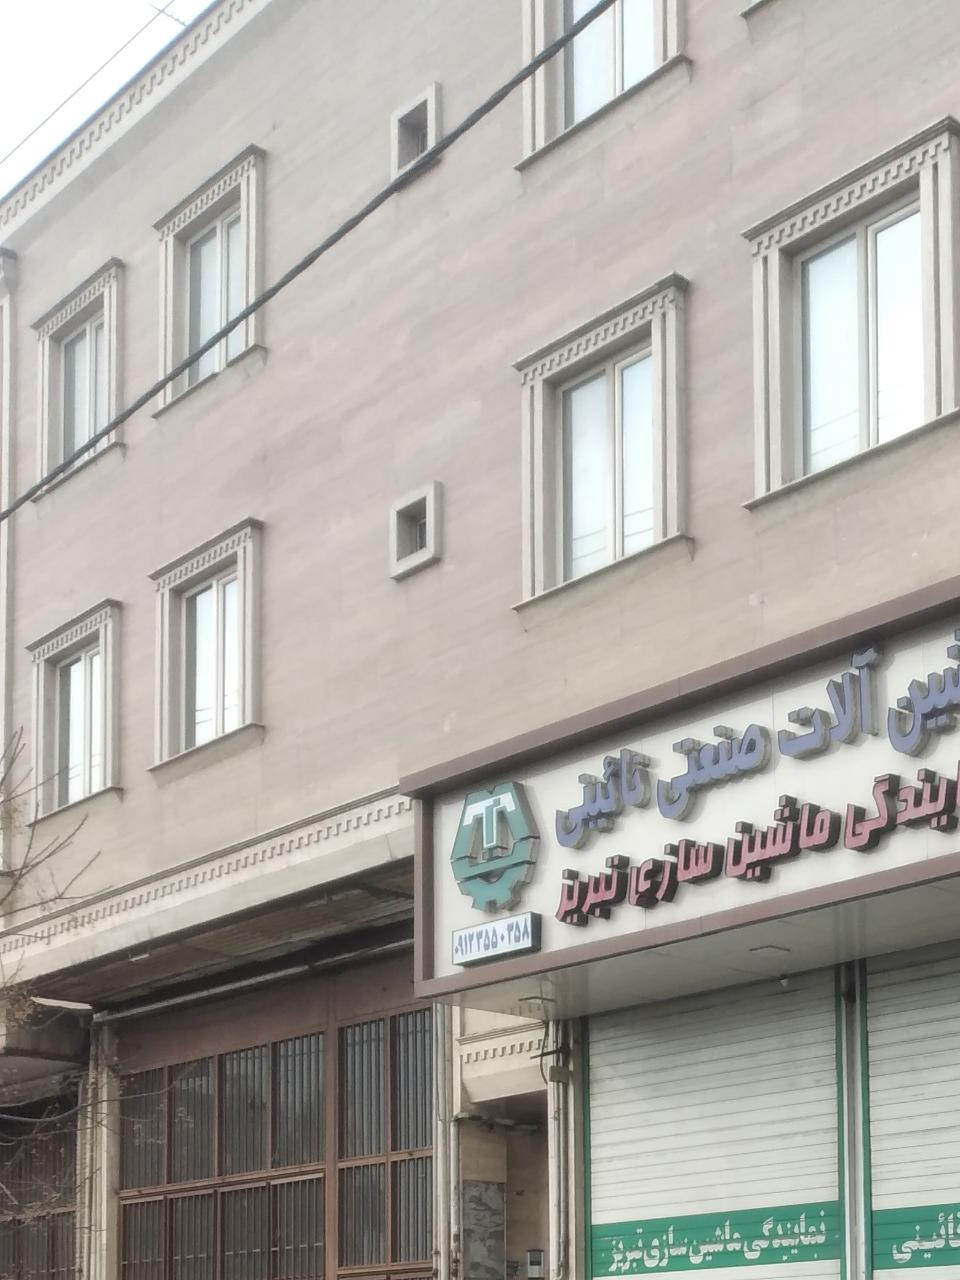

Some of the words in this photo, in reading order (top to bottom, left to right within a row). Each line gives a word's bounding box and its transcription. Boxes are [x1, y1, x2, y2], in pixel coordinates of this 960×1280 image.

[778, 648, 880, 759] آلات
[657, 724, 772, 821] صنعتی
[725, 794, 842, 882] ماشین
[555, 855, 630, 926] تبریز
[628, 839, 725, 908] سازی
[608, 1228, 643, 1273] تبریز
[643, 1225, 687, 1267] سازی
[689, 1219, 741, 1264] ماشین
[744, 1209, 826, 1260] نمایندگی
